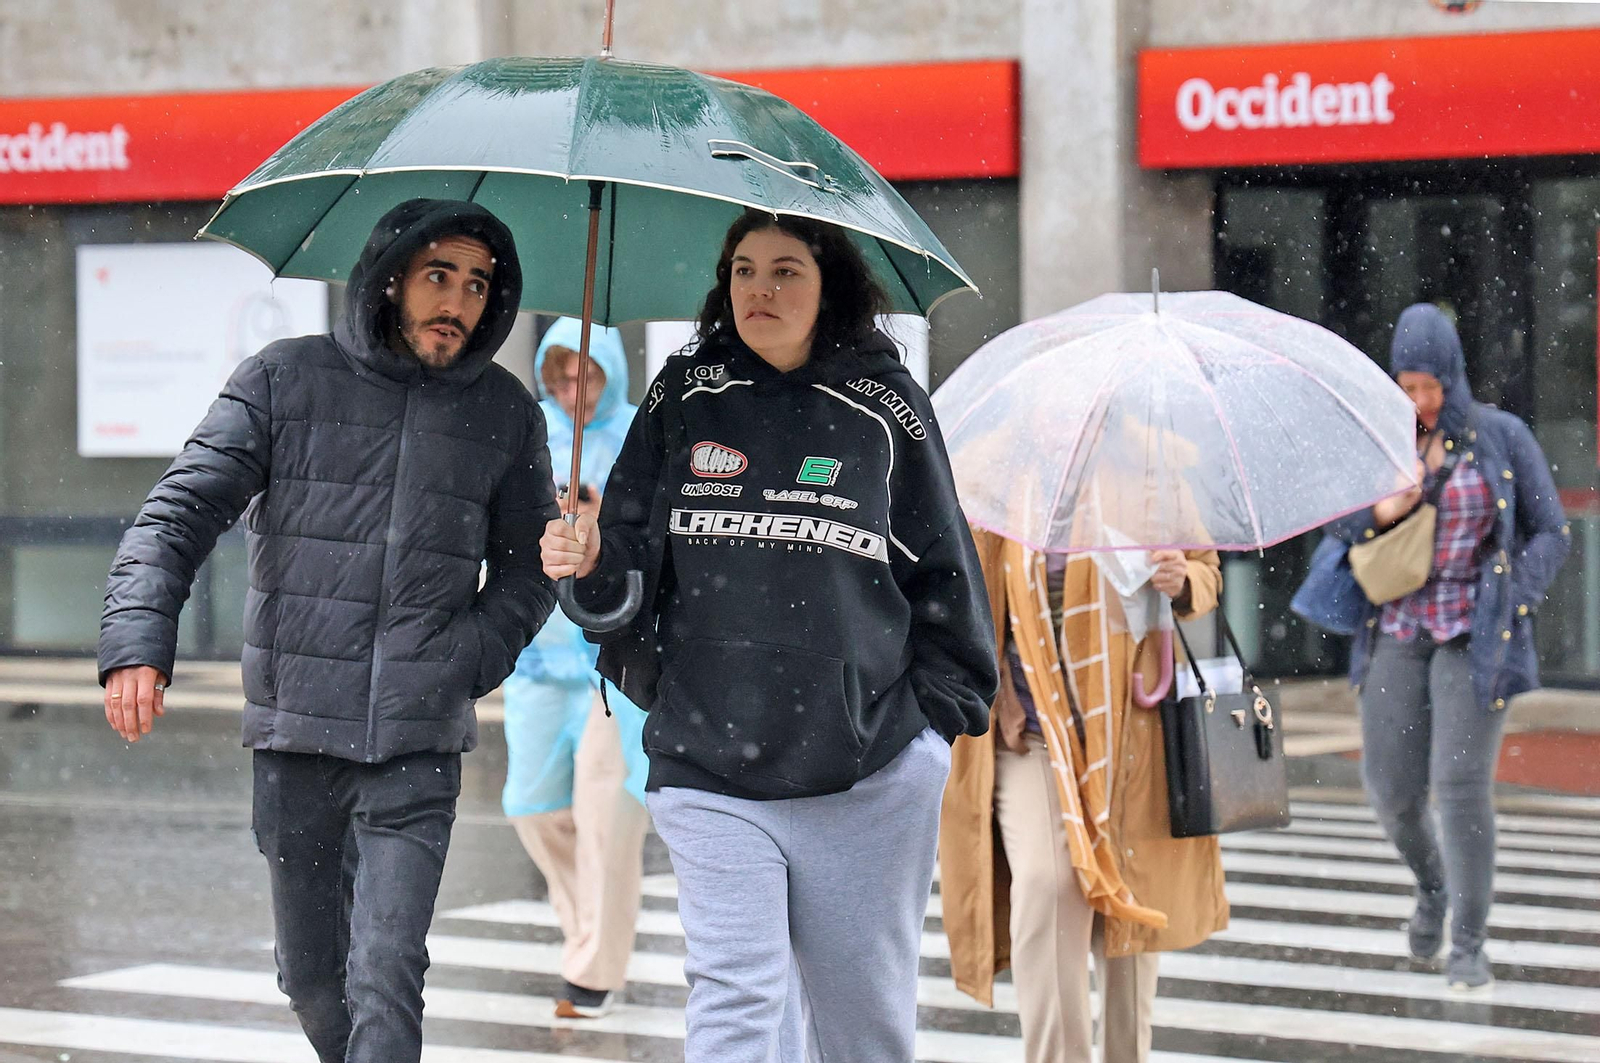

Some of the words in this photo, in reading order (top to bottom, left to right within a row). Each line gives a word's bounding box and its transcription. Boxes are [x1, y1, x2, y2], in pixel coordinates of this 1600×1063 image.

[1175, 71, 1394, 132] Occident
[694, 364, 725, 381] OF
[845, 378, 887, 397] MY
[879, 389, 927, 440] MIND
[796, 456, 838, 486] E
[681, 482, 743, 498] UNLOOSE
[729, 539, 745, 547] OF
[758, 541, 775, 549] MY
[787, 543, 823, 554] MIND
